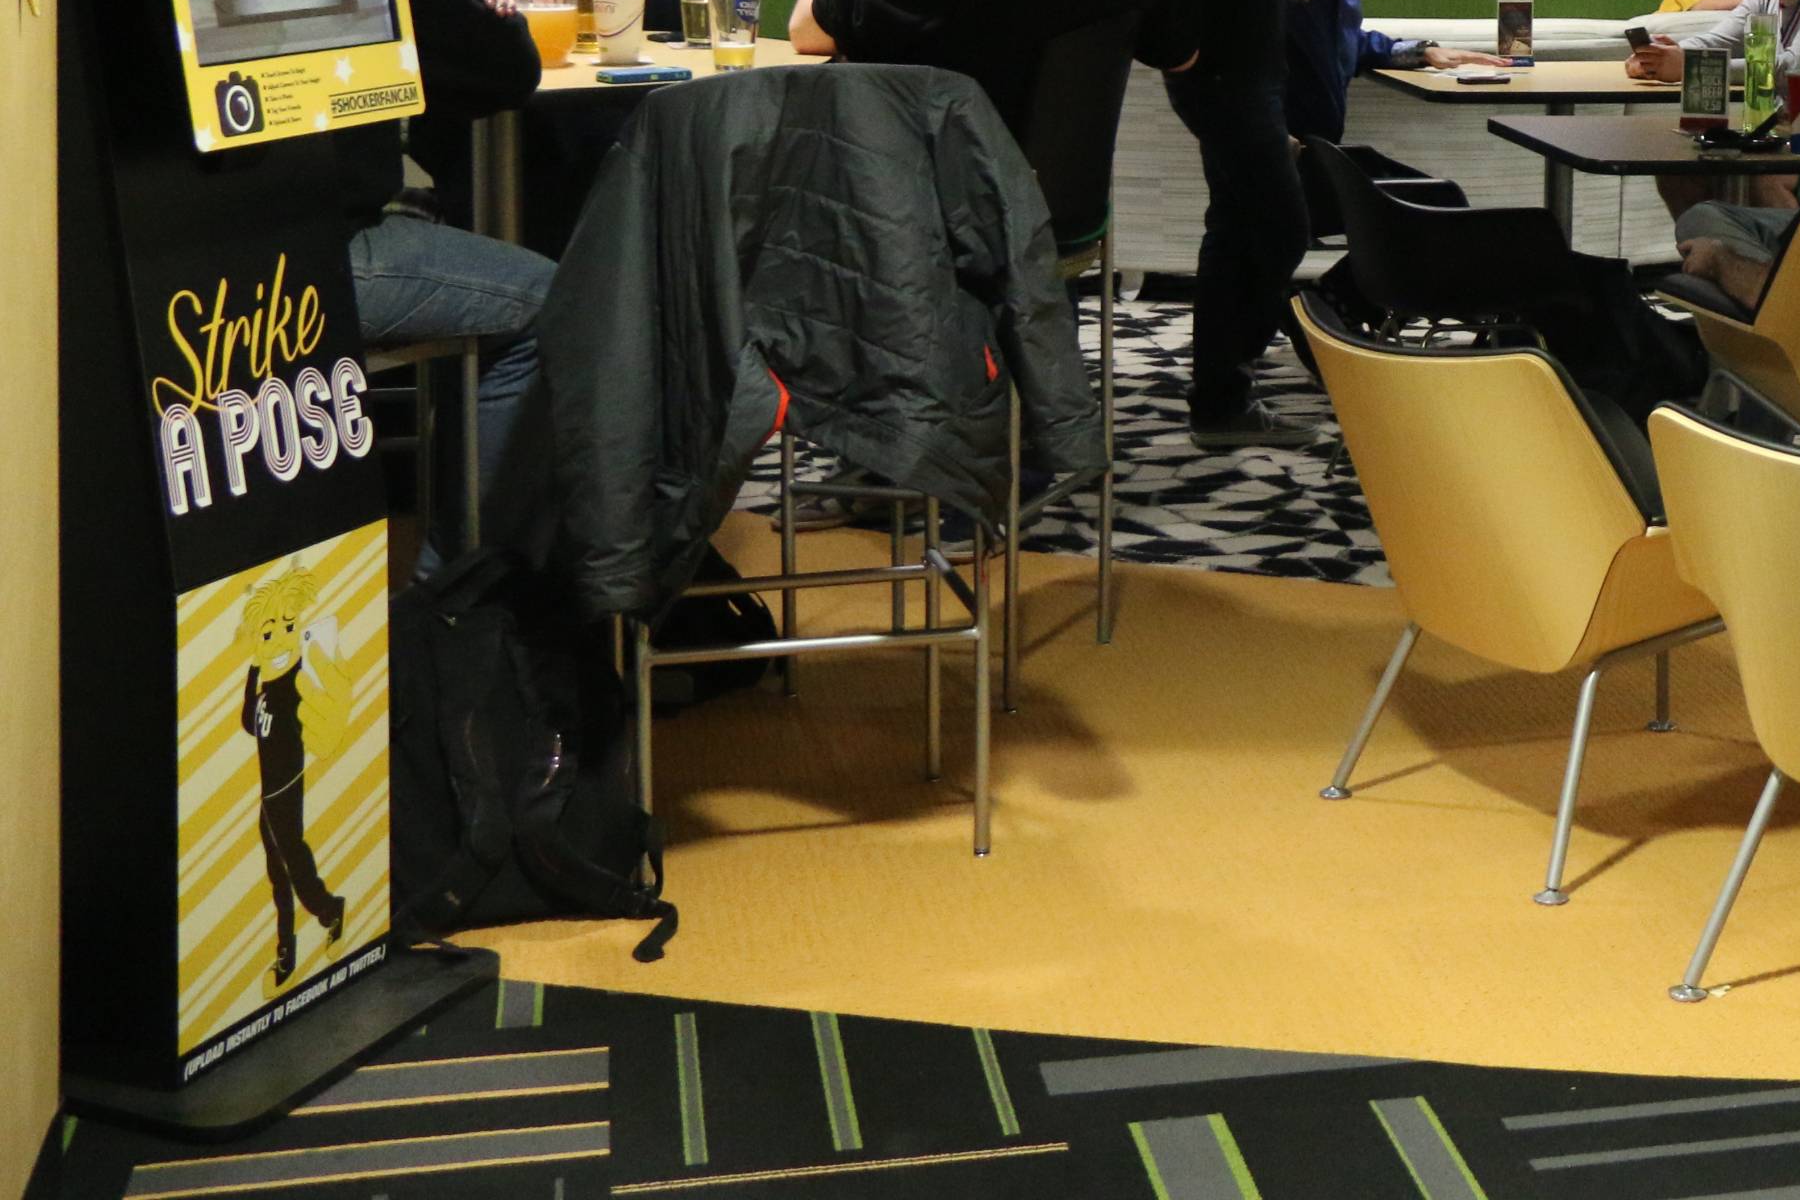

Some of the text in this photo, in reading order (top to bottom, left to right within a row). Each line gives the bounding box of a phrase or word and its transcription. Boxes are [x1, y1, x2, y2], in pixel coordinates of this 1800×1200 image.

[330, 86, 419, 114] #SHOCKERFANCAM
[152, 253, 325, 412] Strike
[159, 356, 375, 515] A POSE
[226, 1012, 271, 1053] INSTANTLY
[273, 1007, 285, 1024] TO
[285, 982, 329, 1017] FACEBOOK
[330, 966, 348, 990] AND
